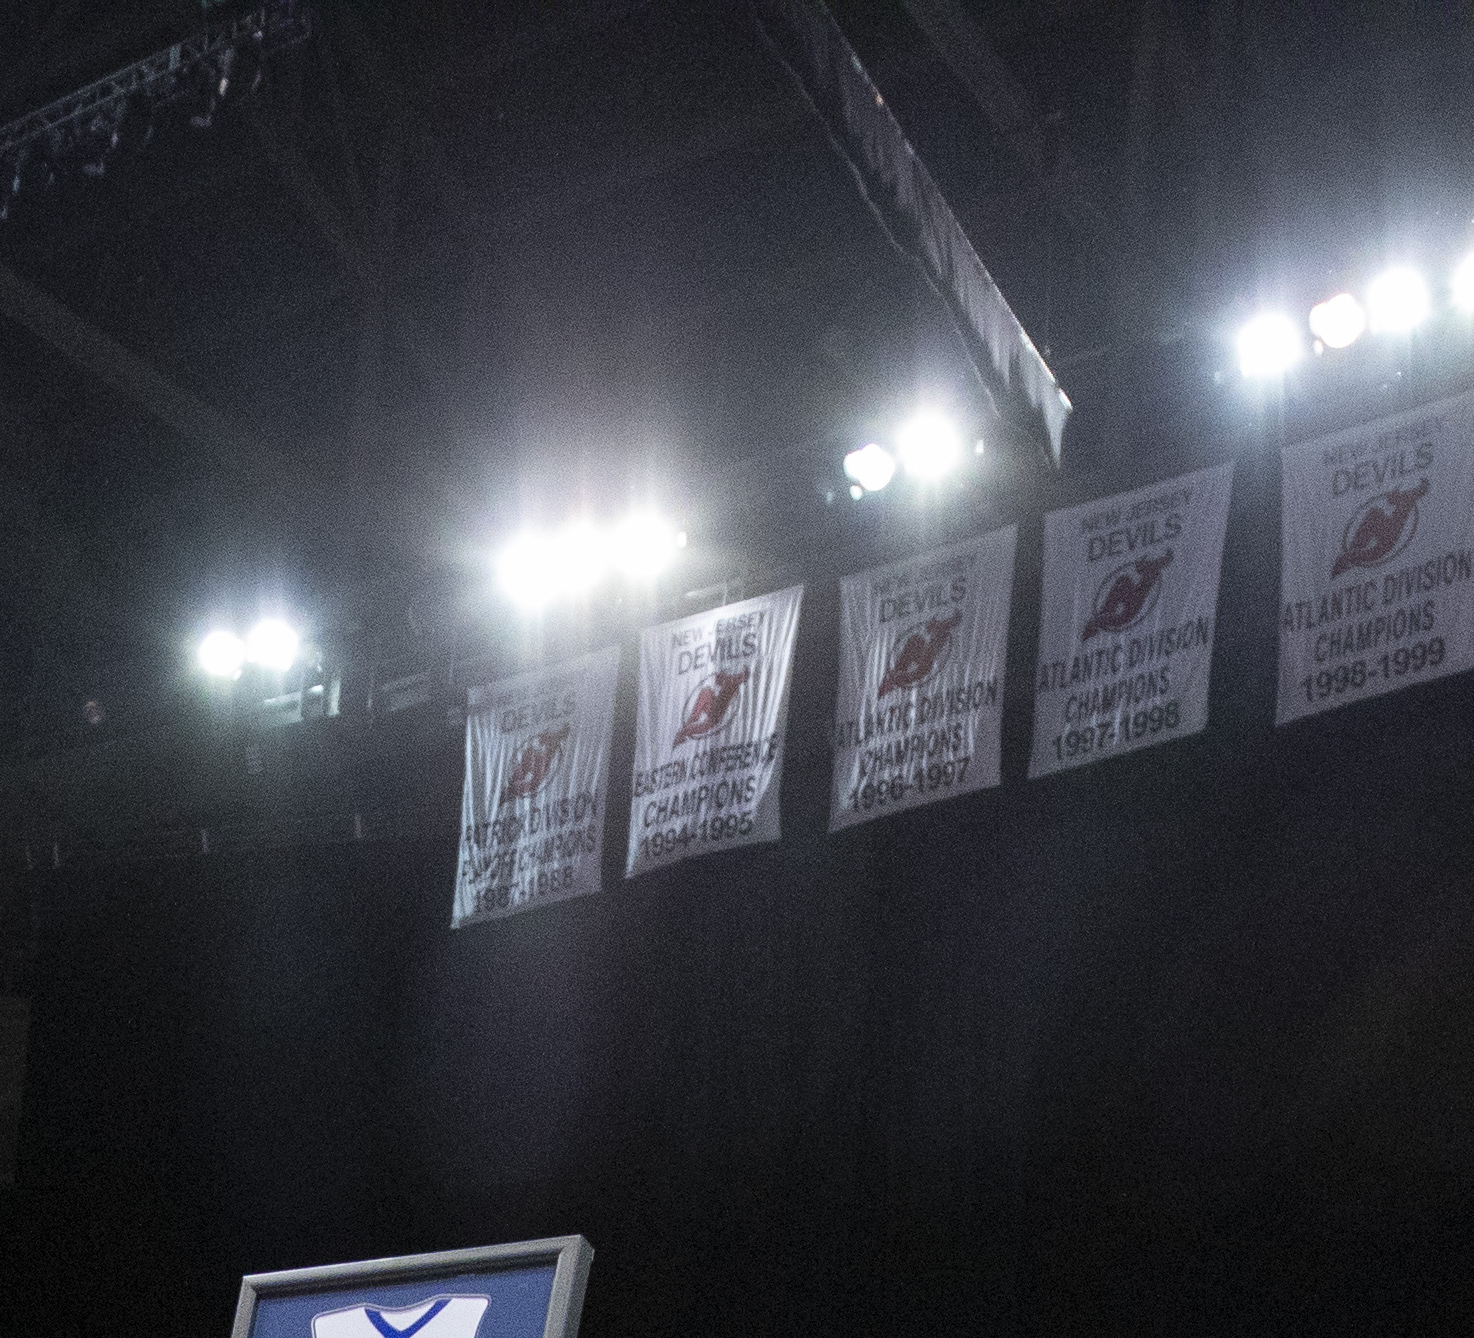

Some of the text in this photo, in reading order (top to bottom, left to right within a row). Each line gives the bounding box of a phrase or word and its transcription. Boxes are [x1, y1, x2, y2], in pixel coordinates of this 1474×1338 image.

[1332, 442, 1434, 496] DEVILS
[1088, 517, 1181, 561] DEVILS
[1284, 551, 1473, 634] ATLANTIC DIVISION
[677, 635, 759, 674] DEVILS
[1037, 617, 1210, 693] ATLANTIC DIVISION
[1315, 600, 1436, 662] CHAMPIONS
[1064, 666, 1170, 720] CHAMPIONS
[1300, 636, 1446, 703] 1998-1999
[1050, 701, 1181, 760] 1997-1998
[633, 732, 781, 799] EASTERN CONFERENCE
[641, 775, 757, 829] CHAMPIONS
[639, 814, 753, 859] 1994-1995
